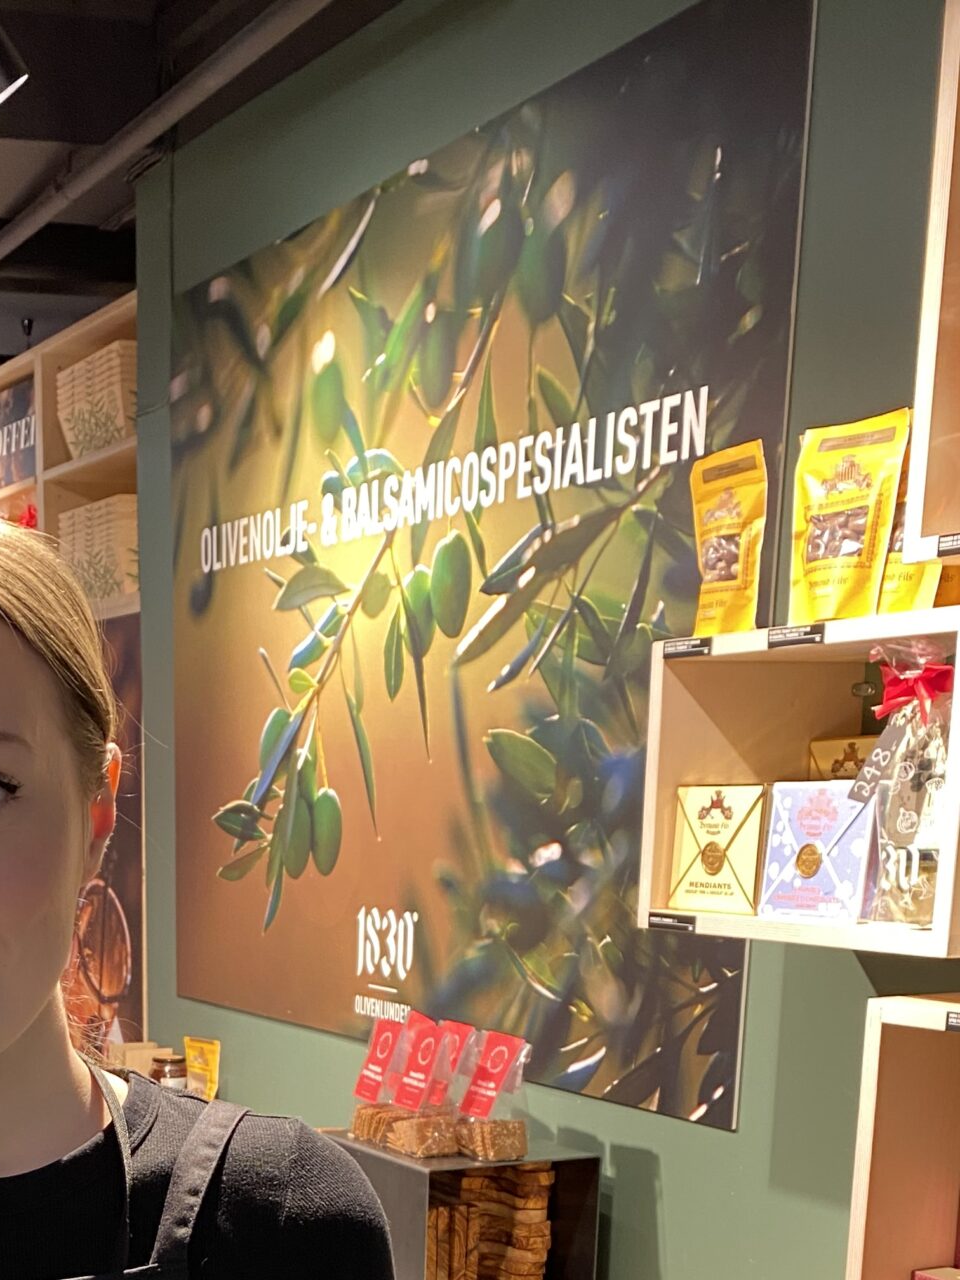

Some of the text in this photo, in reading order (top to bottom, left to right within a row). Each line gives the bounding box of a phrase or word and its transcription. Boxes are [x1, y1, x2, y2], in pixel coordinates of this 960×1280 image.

[201, 385, 710, 574] OLIVENOLJE- & BALSAMICOSPESIALISTEN
